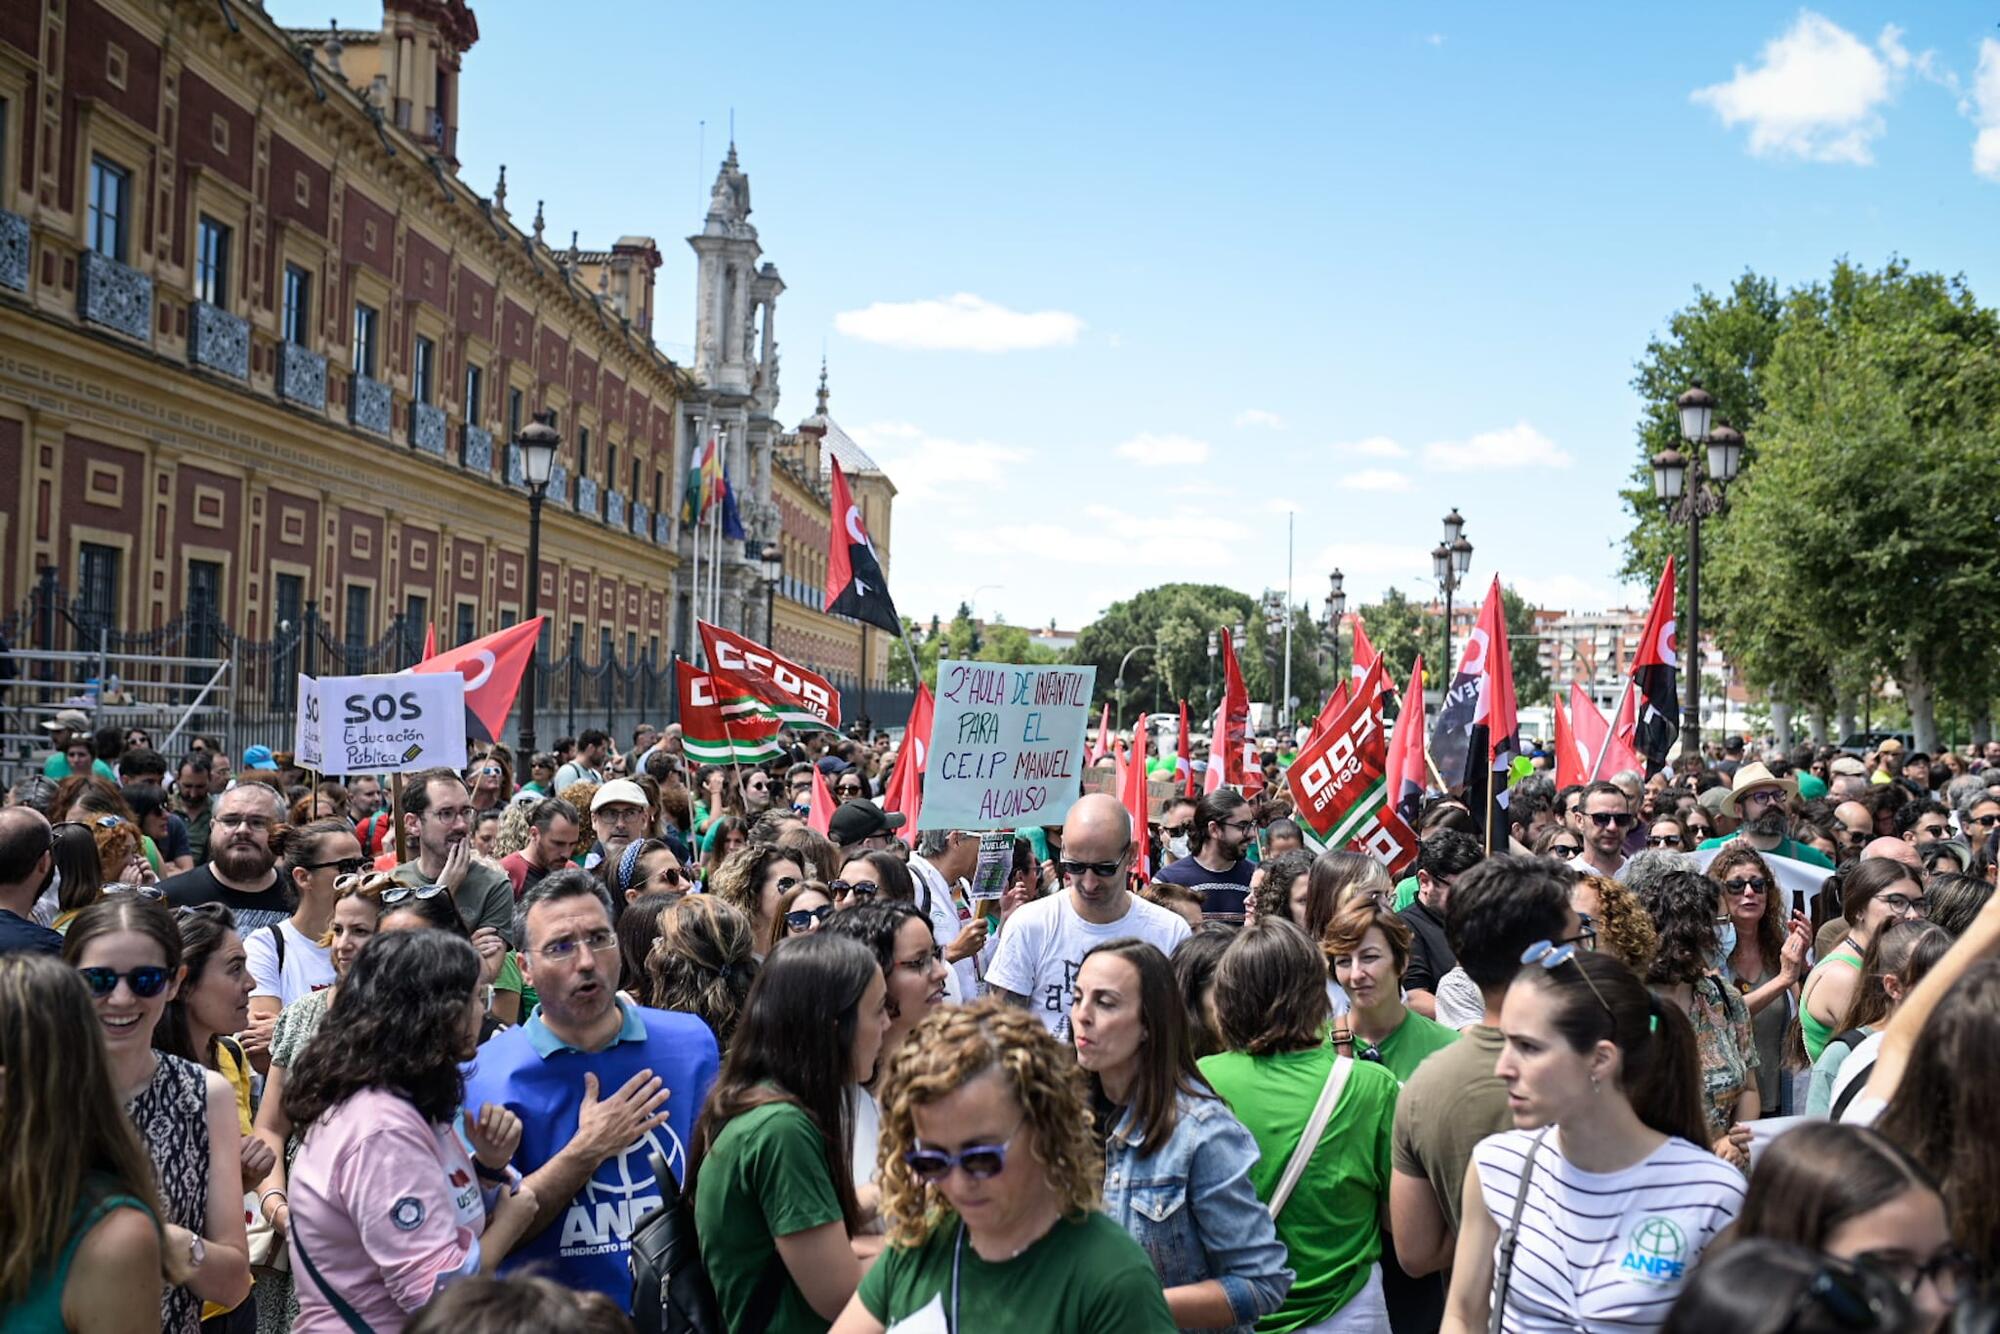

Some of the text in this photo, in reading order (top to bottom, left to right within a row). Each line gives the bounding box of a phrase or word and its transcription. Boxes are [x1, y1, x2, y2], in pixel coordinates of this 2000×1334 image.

[969, 669, 1005, 705] AULA
[1011, 672, 1034, 706] DE
[1034, 671, 1085, 707] INFANTIL
[344, 692, 422, 724] SOS
[343, 725, 424, 744] Educación
[957, 712, 1049, 744] PARA EL
[346, 746, 397, 764] Pública
[1013, 750, 1071, 781] MANUEL
[979, 787, 1046, 819] ALONSO
[560, 1195, 664, 1247] ANP
[560, 1243, 618, 1258] SINDICATO
[1621, 1252, 1685, 1279] ANPE
